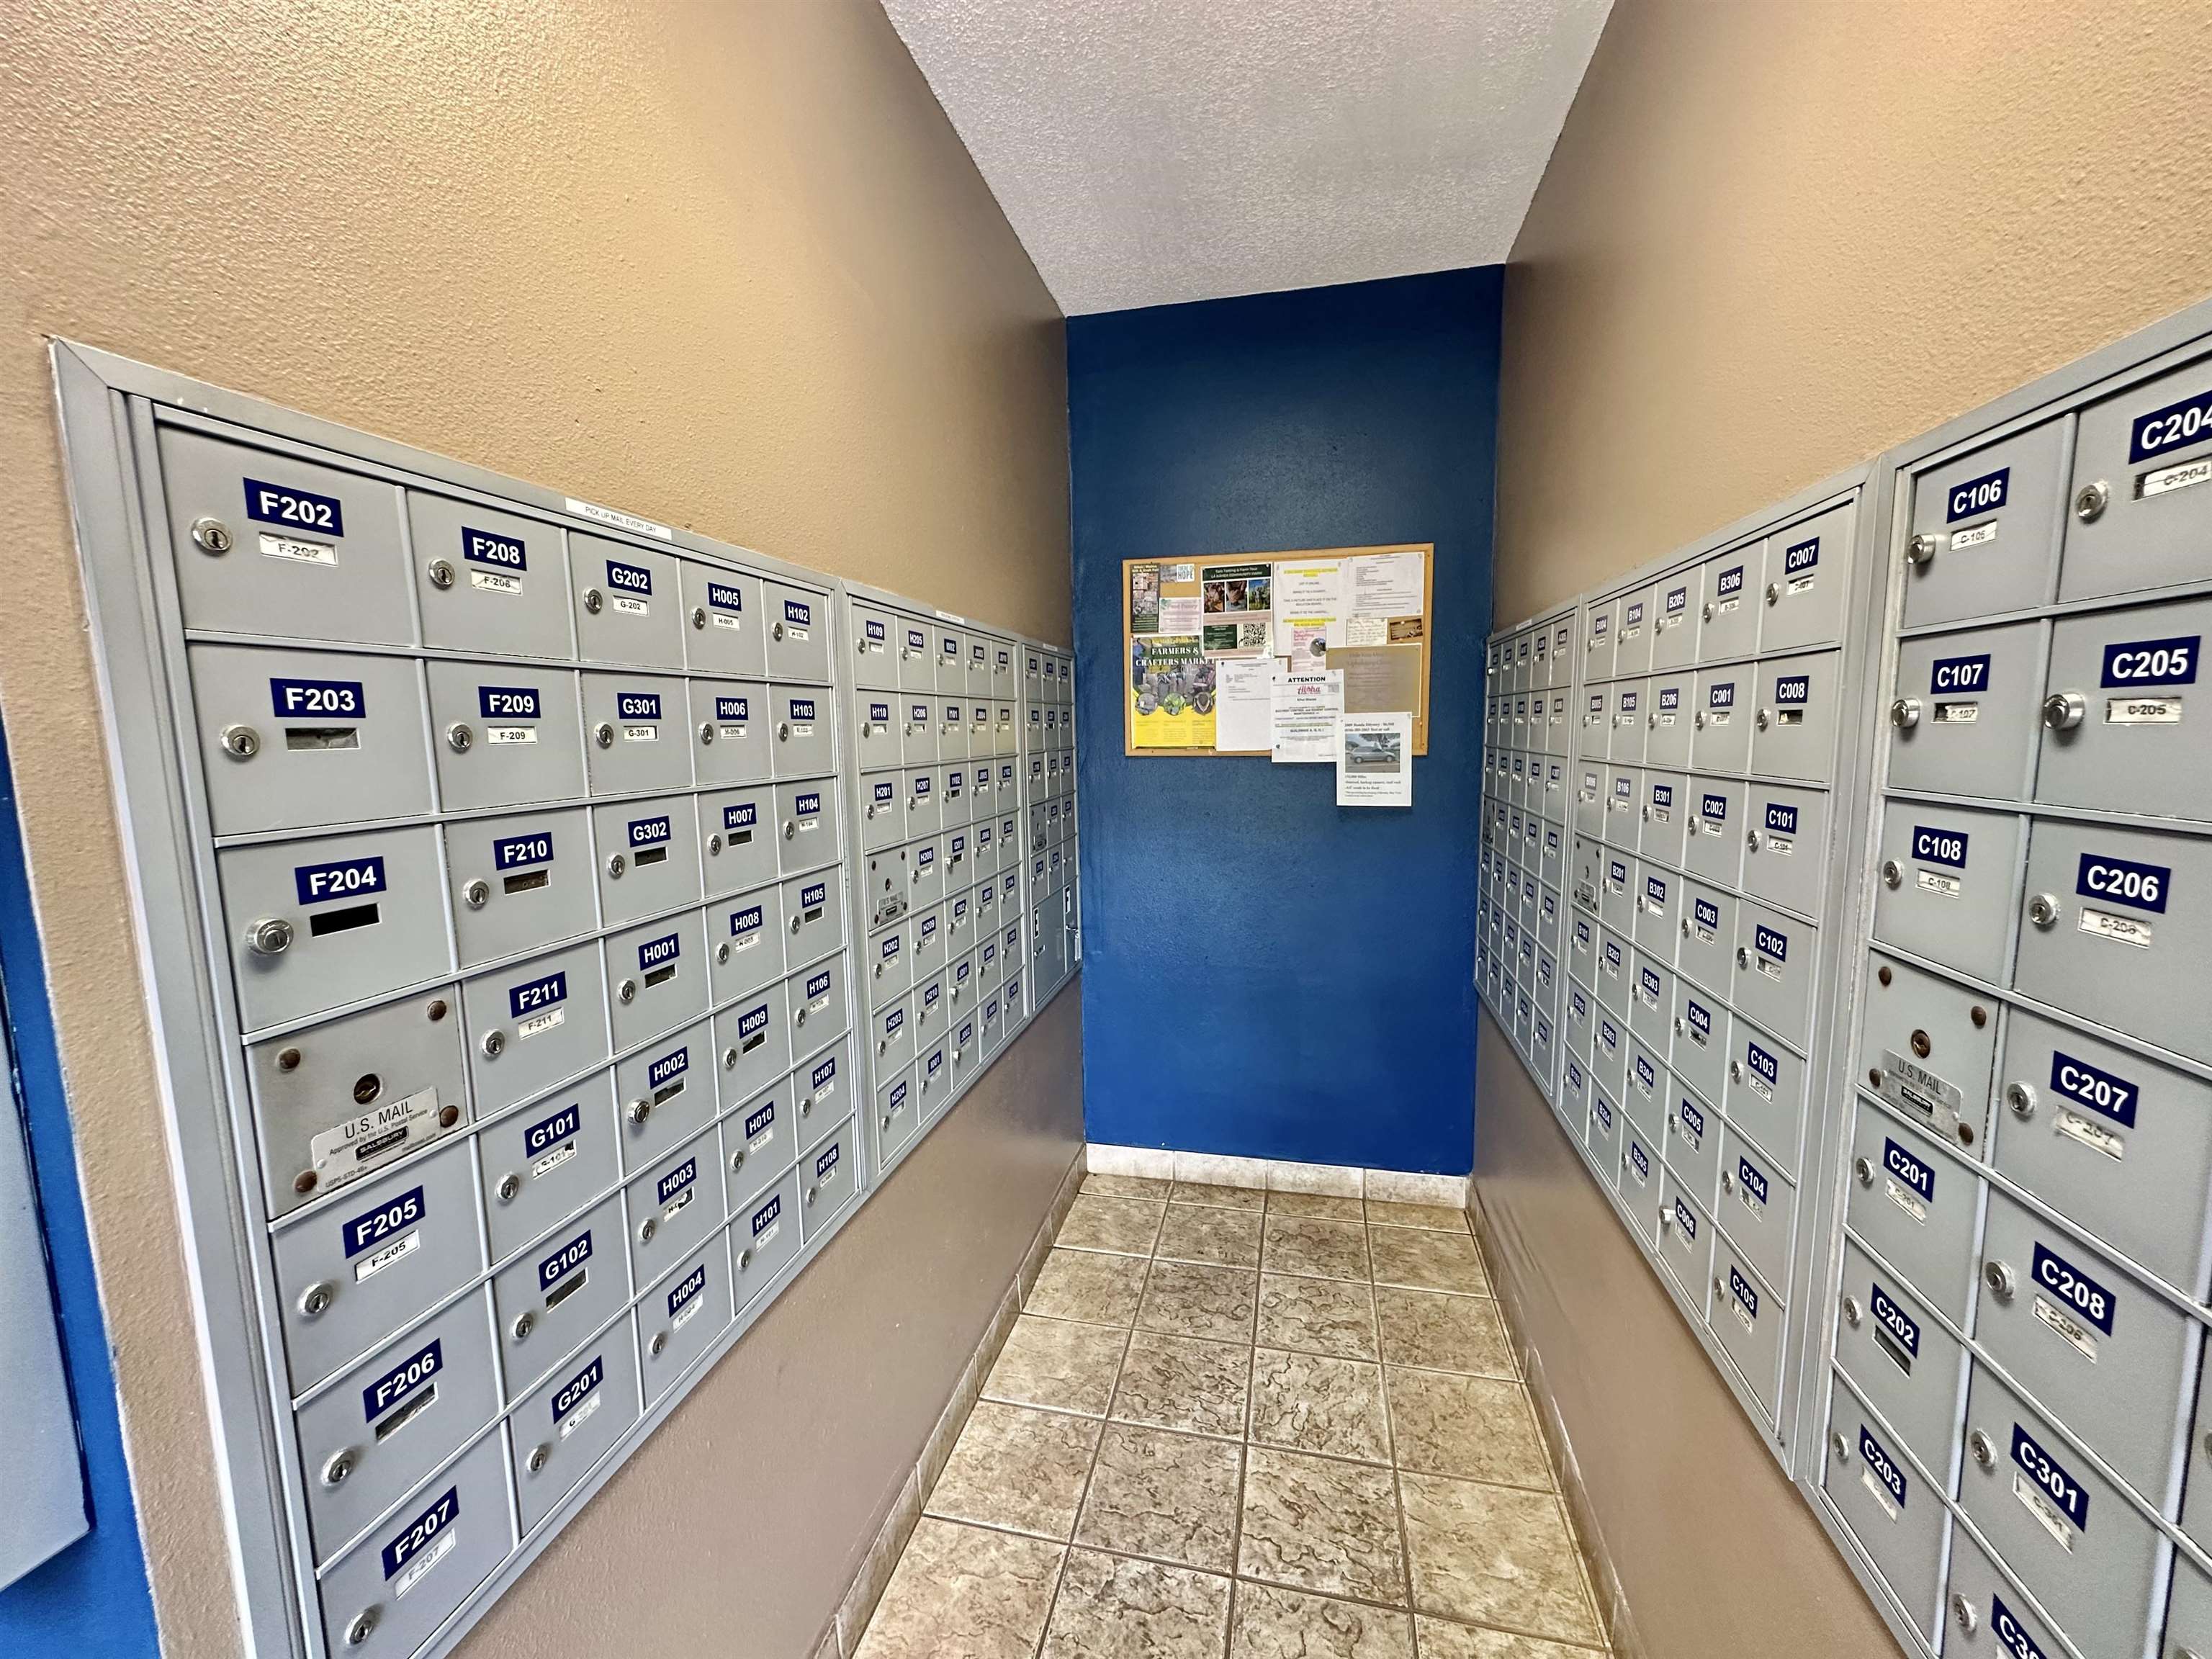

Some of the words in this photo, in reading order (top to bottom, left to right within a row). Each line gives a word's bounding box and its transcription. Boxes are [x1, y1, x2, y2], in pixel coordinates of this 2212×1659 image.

[2141, 405, 2212, 449] C204
[2163, 465, 2208, 486] C-204
[1954, 480, 2002, 513] C106
[260, 491, 333, 527] F202
[585, 506, 599, 516] PICK
[611, 514, 624, 524] MAIL
[626, 518, 644, 528] EVERY
[473, 537, 520, 564] F208
[1789, 545, 1815, 567] C007
[612, 567, 647, 589] G202
[1178, 572, 1193, 580] HOPE
[1721, 572, 1740, 591] B306
[621, 601, 641, 610] G-202
[713, 588, 738, 605] H005
[1669, 593, 1684, 608] B205
[788, 606, 808, 621] H102
[1628, 608, 1641, 621] B104
[868, 624, 883, 637] H109
[909, 634, 922, 645] H205
[1152, 647, 1191, 655] FARMERS
[1181, 656, 1215, 665] MARKET
[2113, 648, 2188, 678] C205
[1938, 664, 1983, 687] C107
[286, 688, 355, 711] F203
[1662, 694, 1676, 706] B206
[1712, 689, 1730, 703] C001
[1779, 683, 1804, 698] C008
[490, 695, 534, 713] F209
[623, 698, 656, 714] G301
[720, 702, 745, 715] H006
[793, 704, 812, 716] H103
[872, 707, 886, 717] H110
[1622, 697, 1635, 707] B105
[2128, 704, 2166, 715] C-205
[913, 709, 926, 717] H206
[500, 732, 526, 740] F-209
[876, 786, 890, 797] H201
[916, 781, 928, 790] H207
[1617, 782, 1629, 793] B106
[799, 798, 818, 811] H104
[1655, 790, 1669, 803] B301
[729, 809, 752, 824] H007
[1705, 800, 1723, 815] C002
[1769, 810, 1793, 828] C101
[634, 822, 667, 840] G302
[504, 840, 547, 863] F210
[1919, 835, 1961, 860] C108
[310, 866, 377, 895] F204
[1612, 866, 1623, 878] B201
[1649, 882, 1663, 899] B302
[2088, 866, 2159, 902] C206
[805, 888, 823, 904] H105
[735, 912, 759, 930] H008
[1698, 904, 1715, 923] C003
[644, 939, 674, 963] H001
[884, 940, 897, 953] H202
[1607, 946, 1619, 962] B202
[1759, 932, 1783, 955] C102
[809, 976, 827, 994] H106
[1644, 973, 1658, 991] B303
[519, 981, 558, 1010] F211
[926, 988, 938, 1001] H210
[528, 1015, 552, 1031] F-211
[742, 1011, 765, 1033] H009
[887, 1013, 902, 1029] H203
[1691, 1007, 1707, 1028] C004
[1603, 1025, 1614, 1043] B203
[655, 1053, 685, 1081] H002
[815, 1063, 832, 1084] H107
[1638, 1061, 1652, 1082] B304
[1751, 1050, 1773, 1076] C103
[1917, 1070, 1941, 1095] MAIL
[2061, 1066, 2128, 1112] C207
[891, 1086, 904, 1103] H204
[346, 1118, 374, 1138] U.S.
[379, 1101, 413, 1124] MAIL
[750, 1108, 772, 1133] H010
[1599, 1104, 1609, 1123] B204
[1684, 1106, 1701, 1130] C005
[330, 1138, 358, 1155] Approved
[368, 1130, 377, 1139] the
[390, 1117, 408, 1128] Postal
[409, 1109, 428, 1120] Service
[531, 1113, 573, 1147] G101
[819, 1149, 837, 1172] H108
[1633, 1148, 1647, 1172] B305
[1889, 1150, 1927, 1191] C201
[663, 1164, 693, 1195] H003
[1743, 1165, 1764, 1196] C104
[357, 1198, 417, 1245] F205
[756, 1202, 777, 1230] H101
[1678, 1205, 1694, 1233] C006
[372, 1242, 406, 1267] F-205
[546, 1240, 588, 1279] G102
[673, 1272, 702, 1308] H004
[1733, 1275, 1754, 1309] C105
[2042, 1259, 2104, 1319] C208
[1876, 1297, 1914, 1346] C202
[377, 1353, 434, 1407] F206
[559, 1366, 596, 1411] G201
[1865, 1439, 1900, 1494] C203
[2020, 1442, 2077, 1512] C301
[395, 1499, 449, 1563] F207
